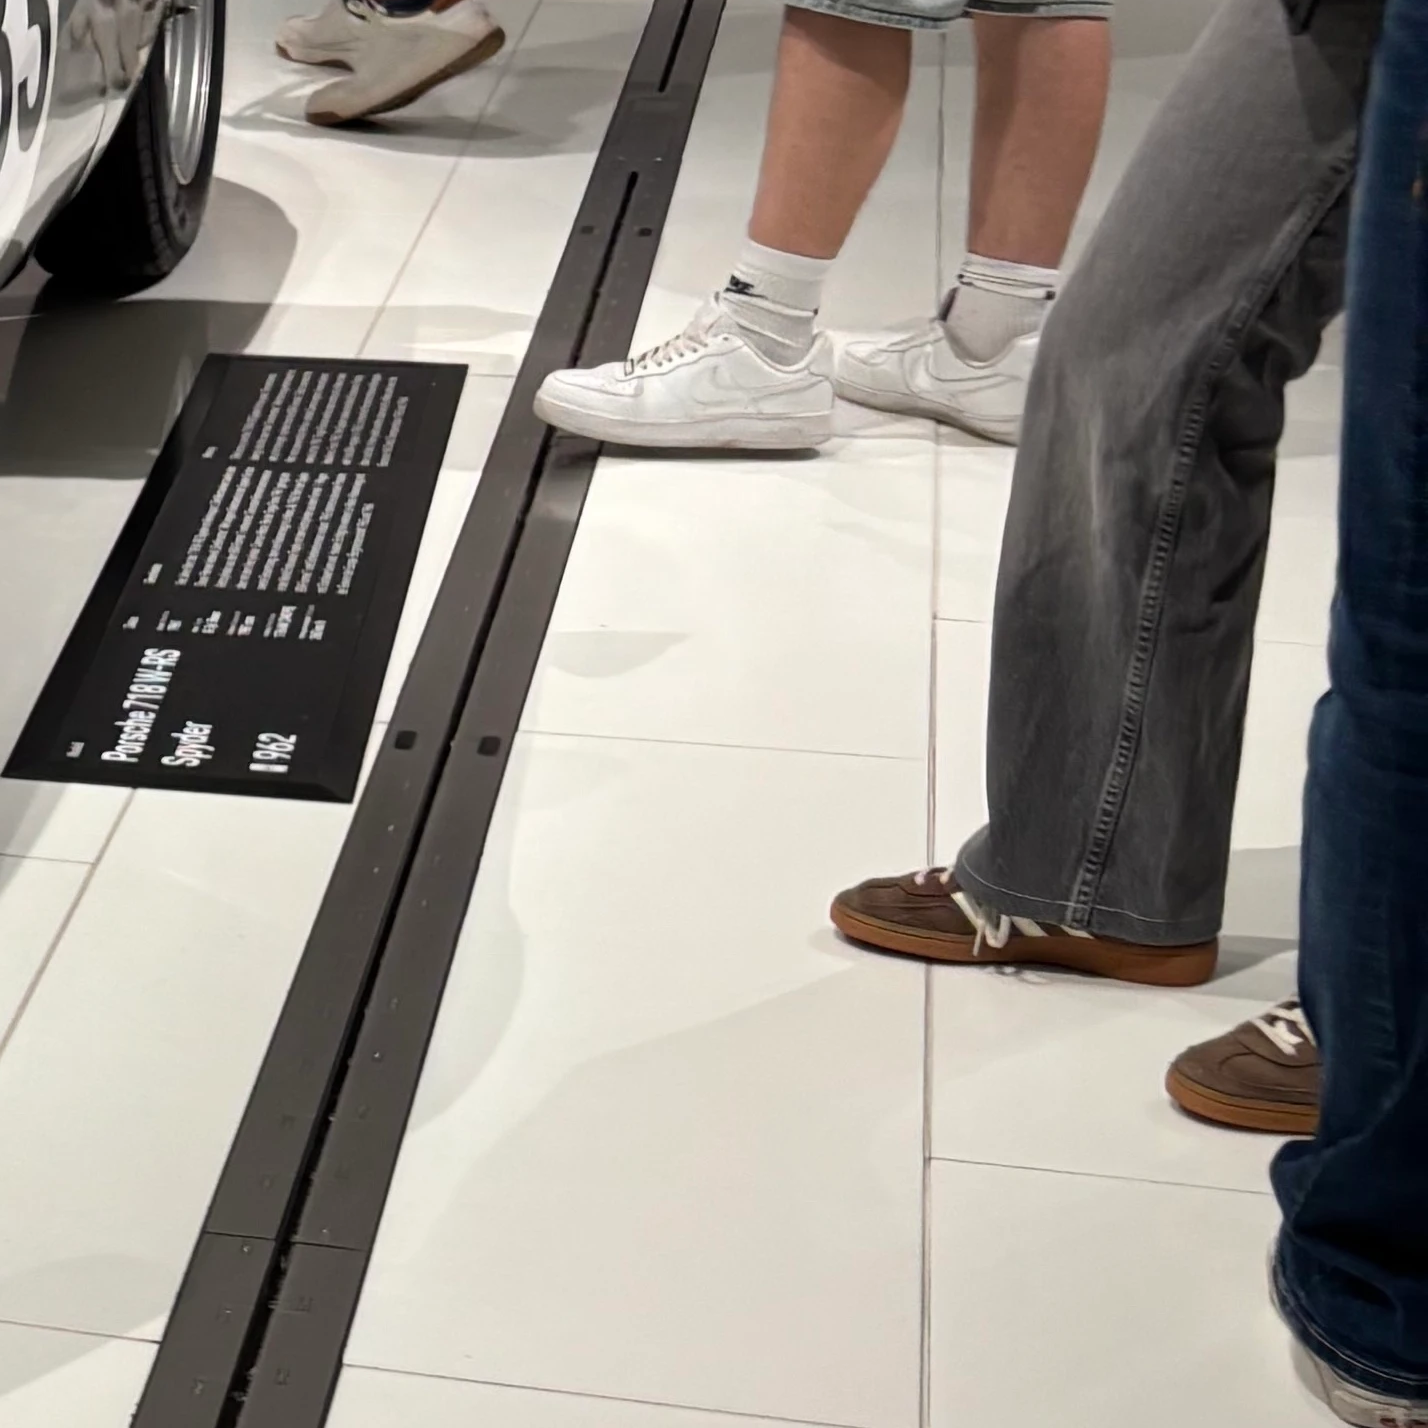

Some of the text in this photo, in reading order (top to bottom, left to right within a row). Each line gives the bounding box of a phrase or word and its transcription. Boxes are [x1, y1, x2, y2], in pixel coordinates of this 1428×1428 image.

[101, 648, 181, 763] Porsche 718 W-RS
[161, 720, 215, 768] Spyder
[249, 732, 297, 774] 1962
